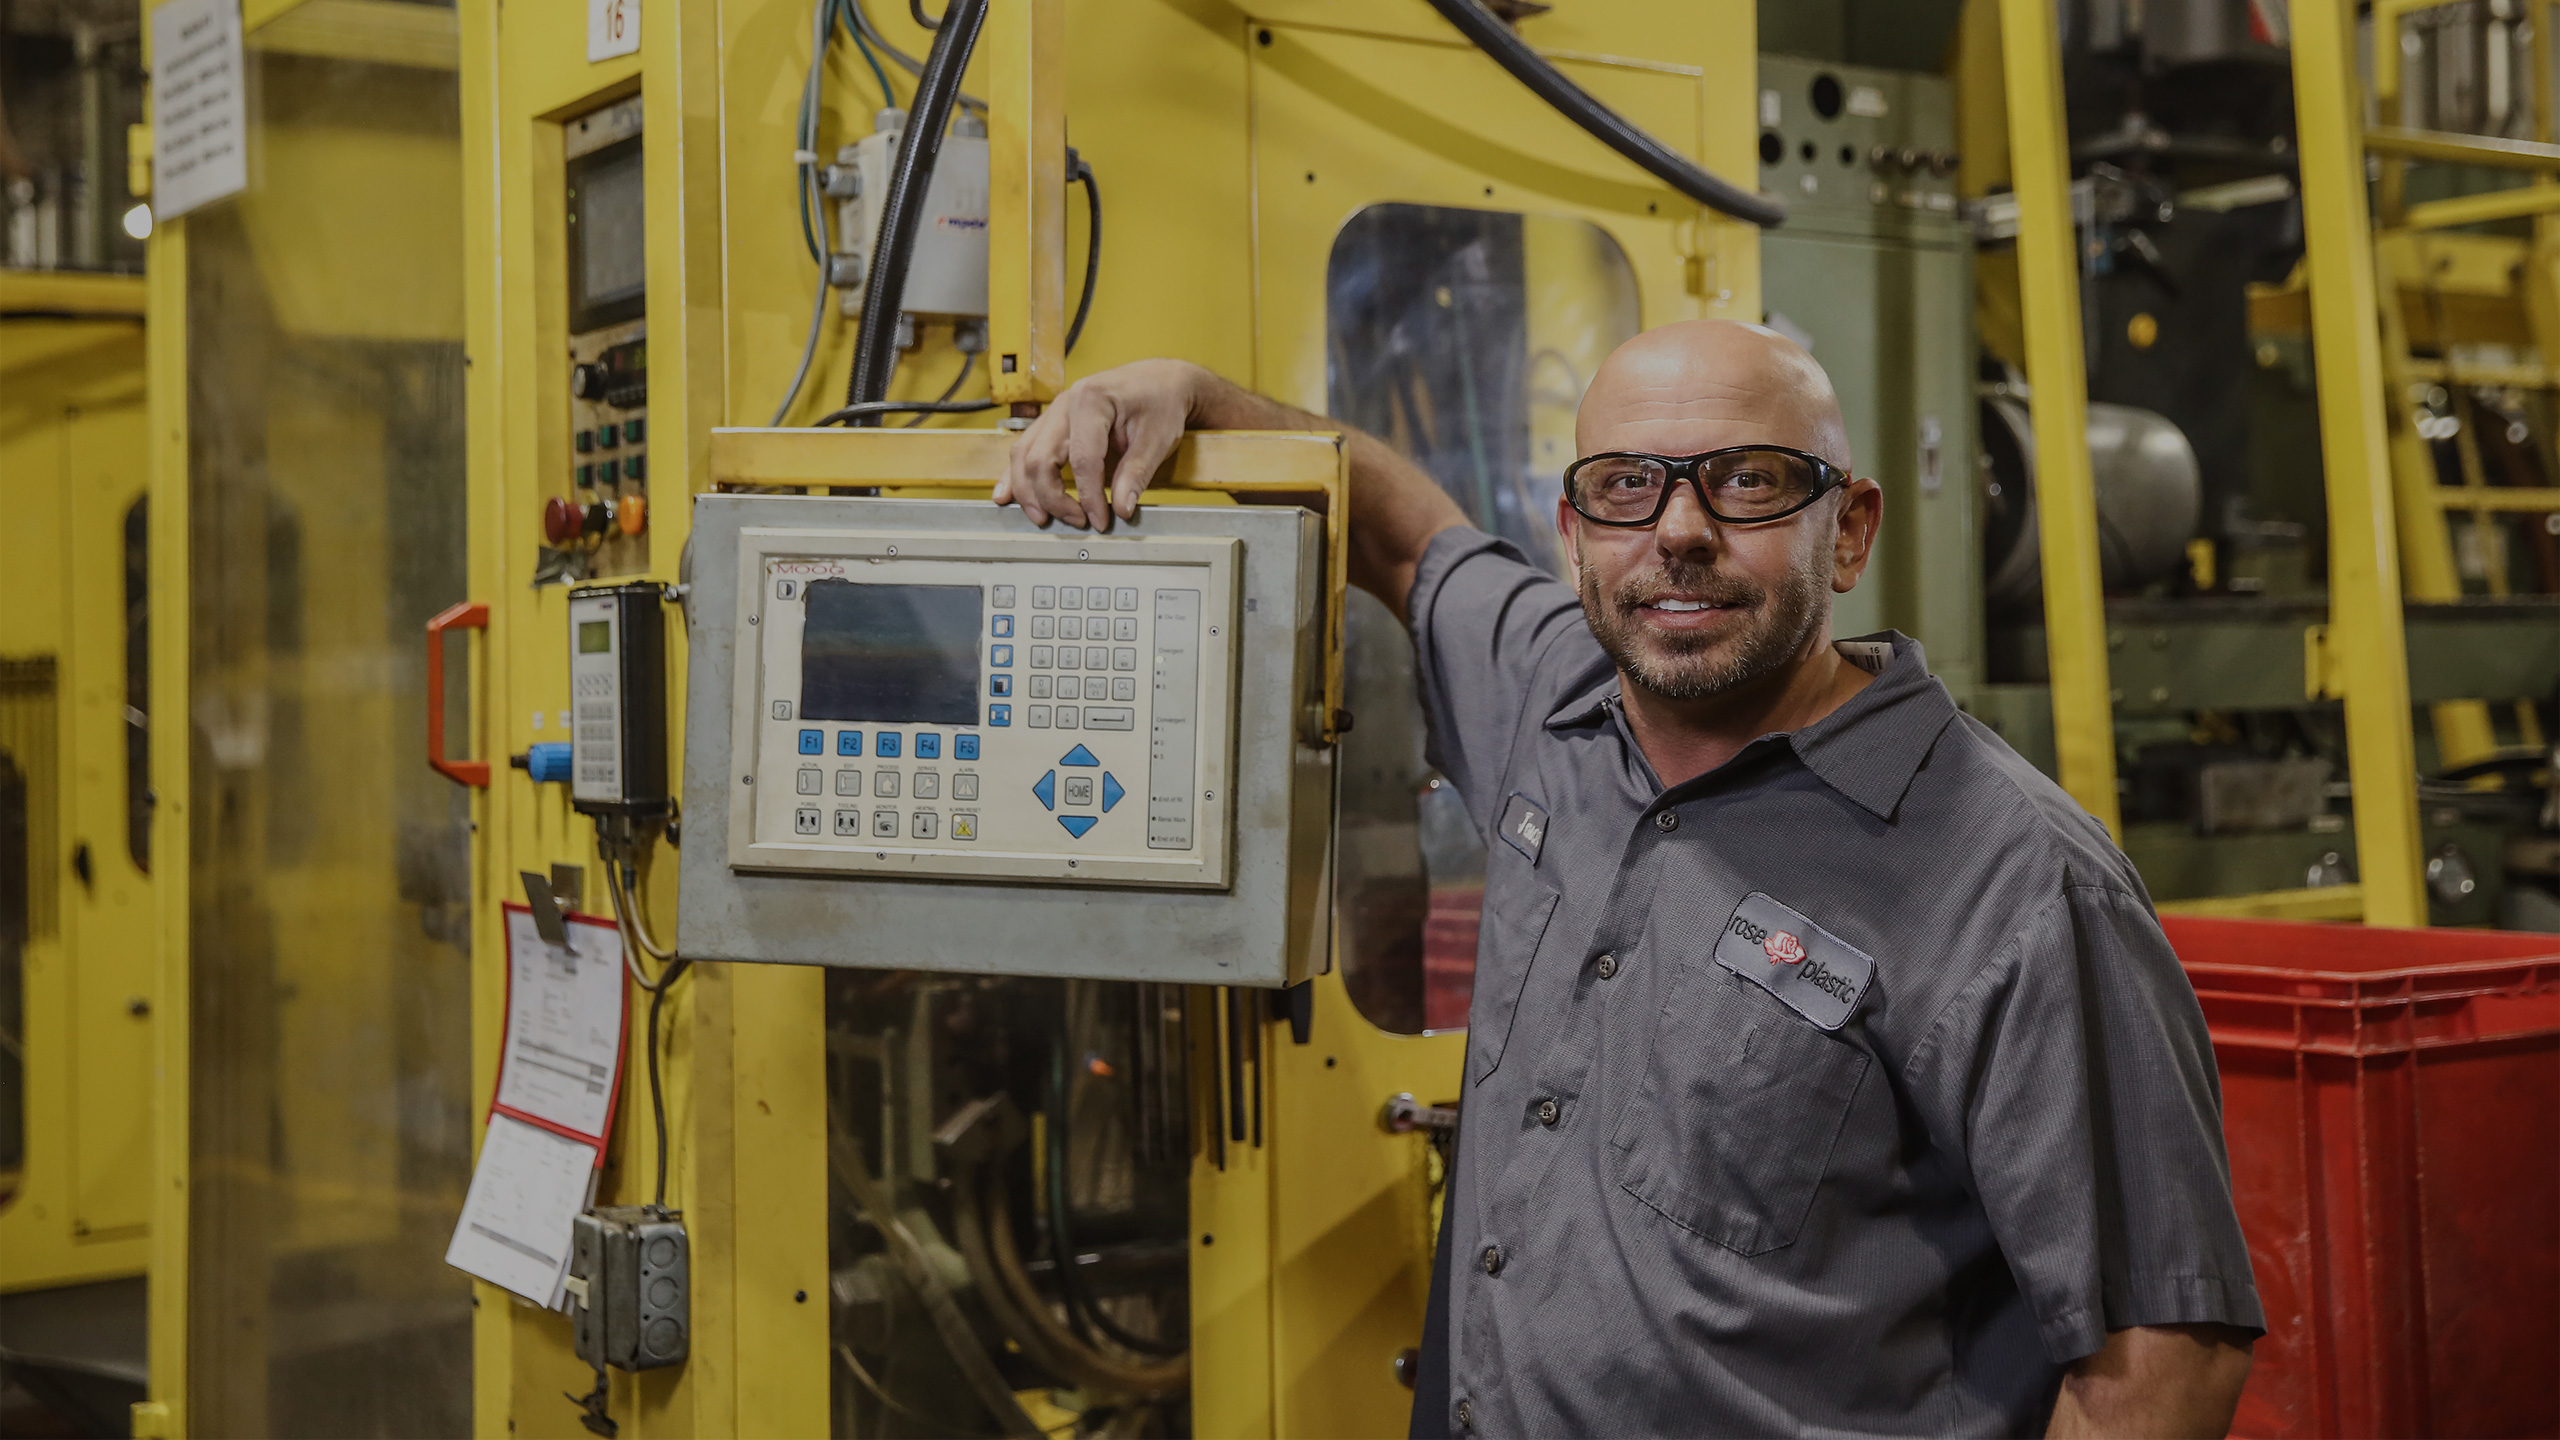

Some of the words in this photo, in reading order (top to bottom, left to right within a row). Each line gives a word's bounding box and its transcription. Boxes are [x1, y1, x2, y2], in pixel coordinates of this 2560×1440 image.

[605, 0, 624, 42] 16
[776, 564, 845, 575] MOOG
[1869, 646, 1880, 654] 16
[805, 736, 818, 749] F1
[843, 737, 857, 751] F2
[882, 738, 897, 751] F3
[921, 739, 935, 753] F4
[960, 741, 975, 754] F5
[1068, 785, 1090, 798] HOME
[1729, 915, 1767, 945] rose
[1796, 959, 1855, 1004] plastic
